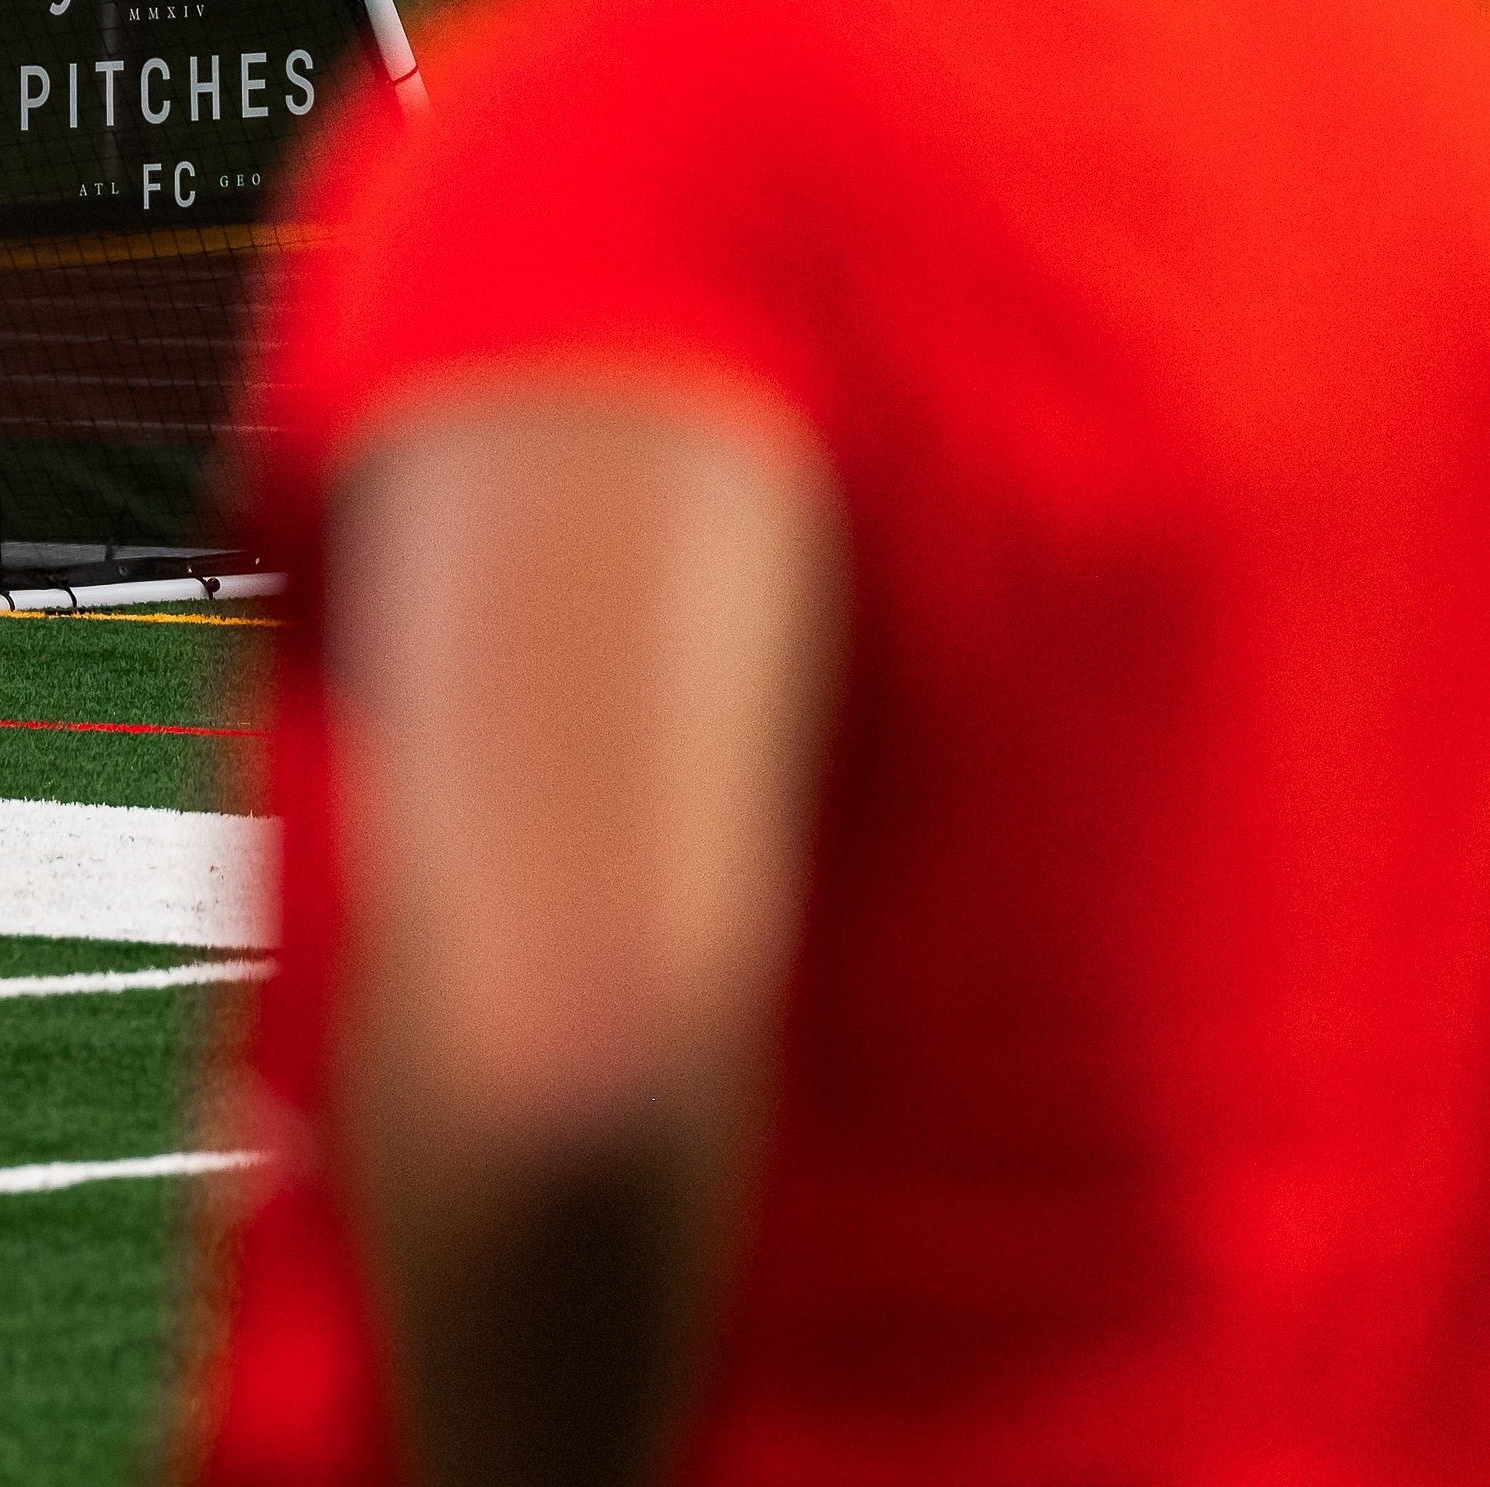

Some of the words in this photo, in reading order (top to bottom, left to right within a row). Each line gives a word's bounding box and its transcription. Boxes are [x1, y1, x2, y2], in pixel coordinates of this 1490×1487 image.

[128, 4, 205, 21] MMXIV
[19, 49, 316, 131] PITCHES
[79, 182, 119, 196] ATL
[142, 160, 196, 210] FC
[219, 173, 261, 188] GEO
